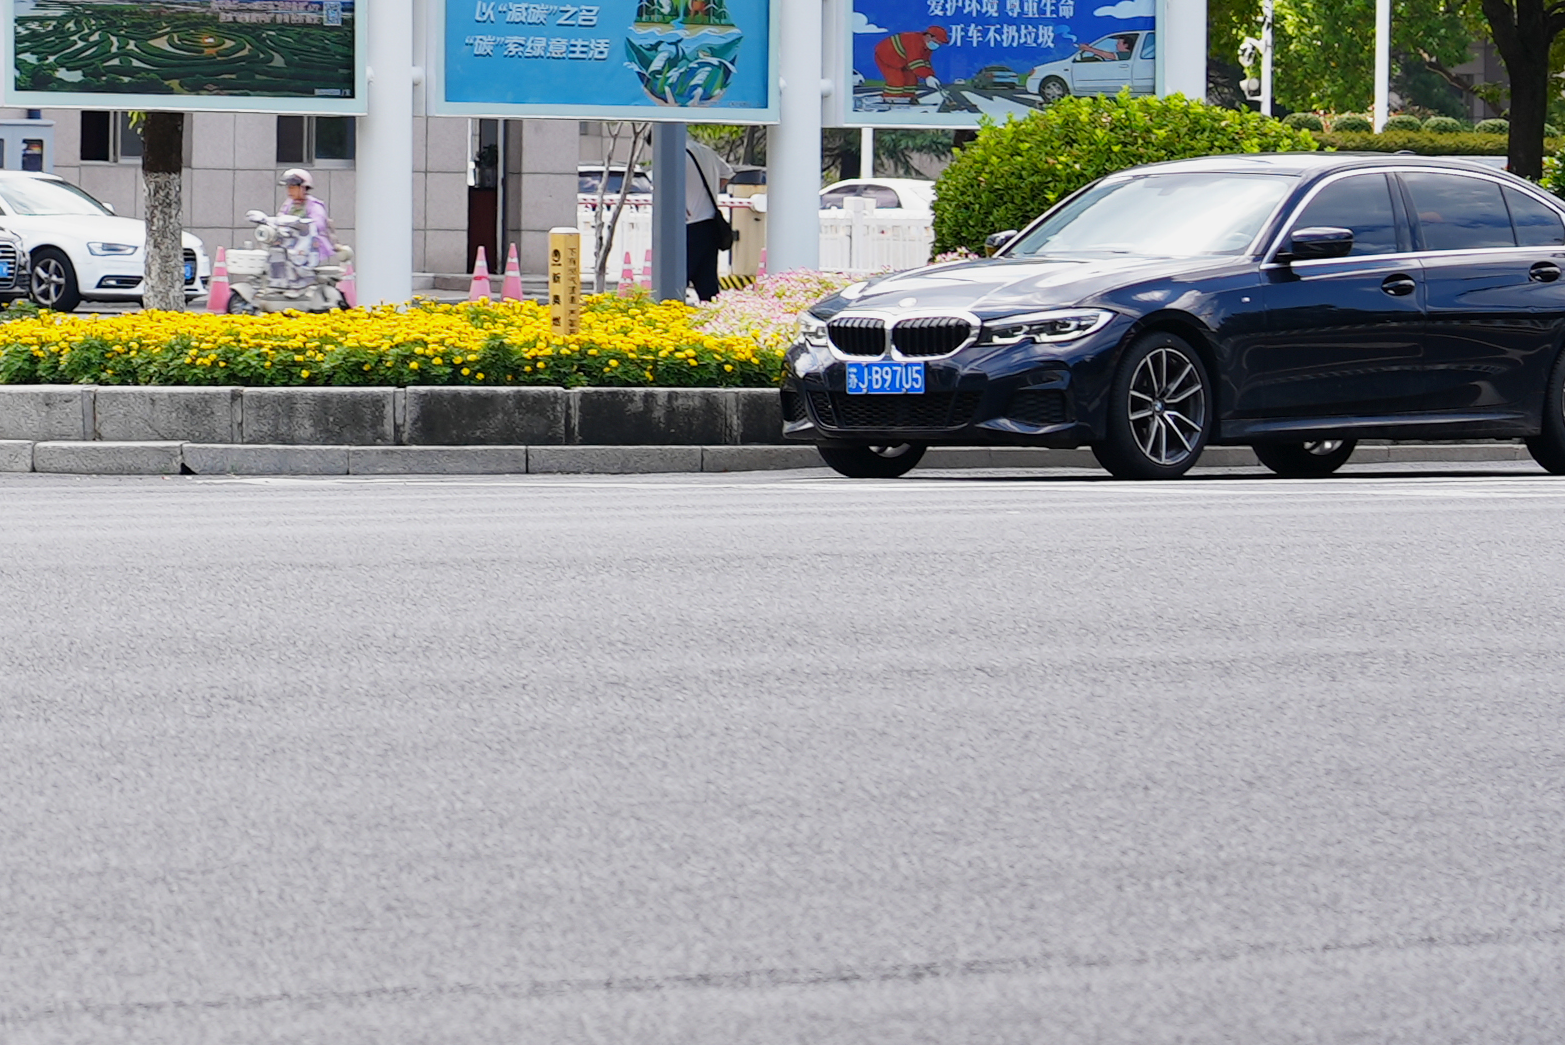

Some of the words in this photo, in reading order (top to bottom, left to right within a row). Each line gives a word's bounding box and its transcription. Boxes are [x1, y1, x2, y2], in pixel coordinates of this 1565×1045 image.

[474, 0, 600, 27] 以“减碳”之名
[464, 35, 611, 61] “碳”索绿意生活
[948, 23, 1055, 48] 开车不扔垃圾
